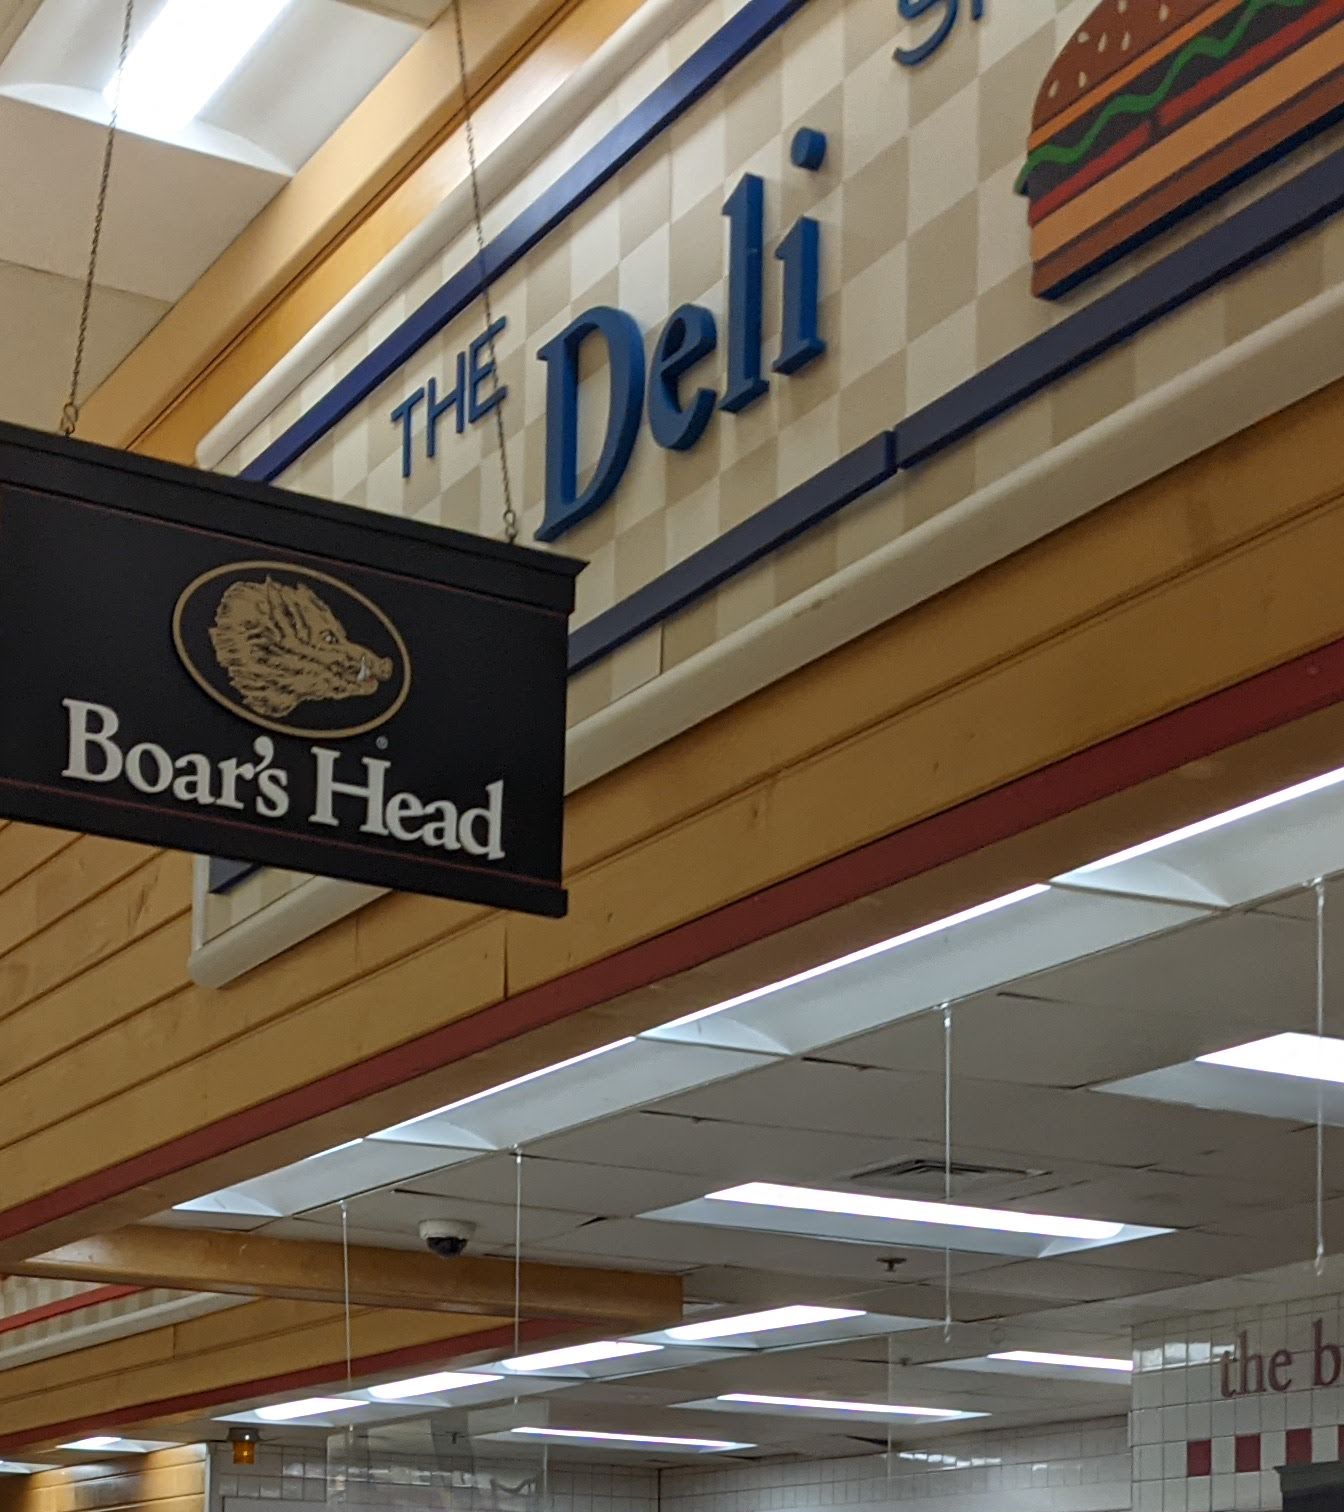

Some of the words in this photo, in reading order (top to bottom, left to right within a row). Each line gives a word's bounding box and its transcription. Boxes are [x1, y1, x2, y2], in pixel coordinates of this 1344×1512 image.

[390, 318, 508, 478] THE
[535, 124, 829, 540] Deli
[62, 698, 291, 818] Boar's
[309, 745, 506, 860] Head
[1220, 1329, 1295, 1397] the
